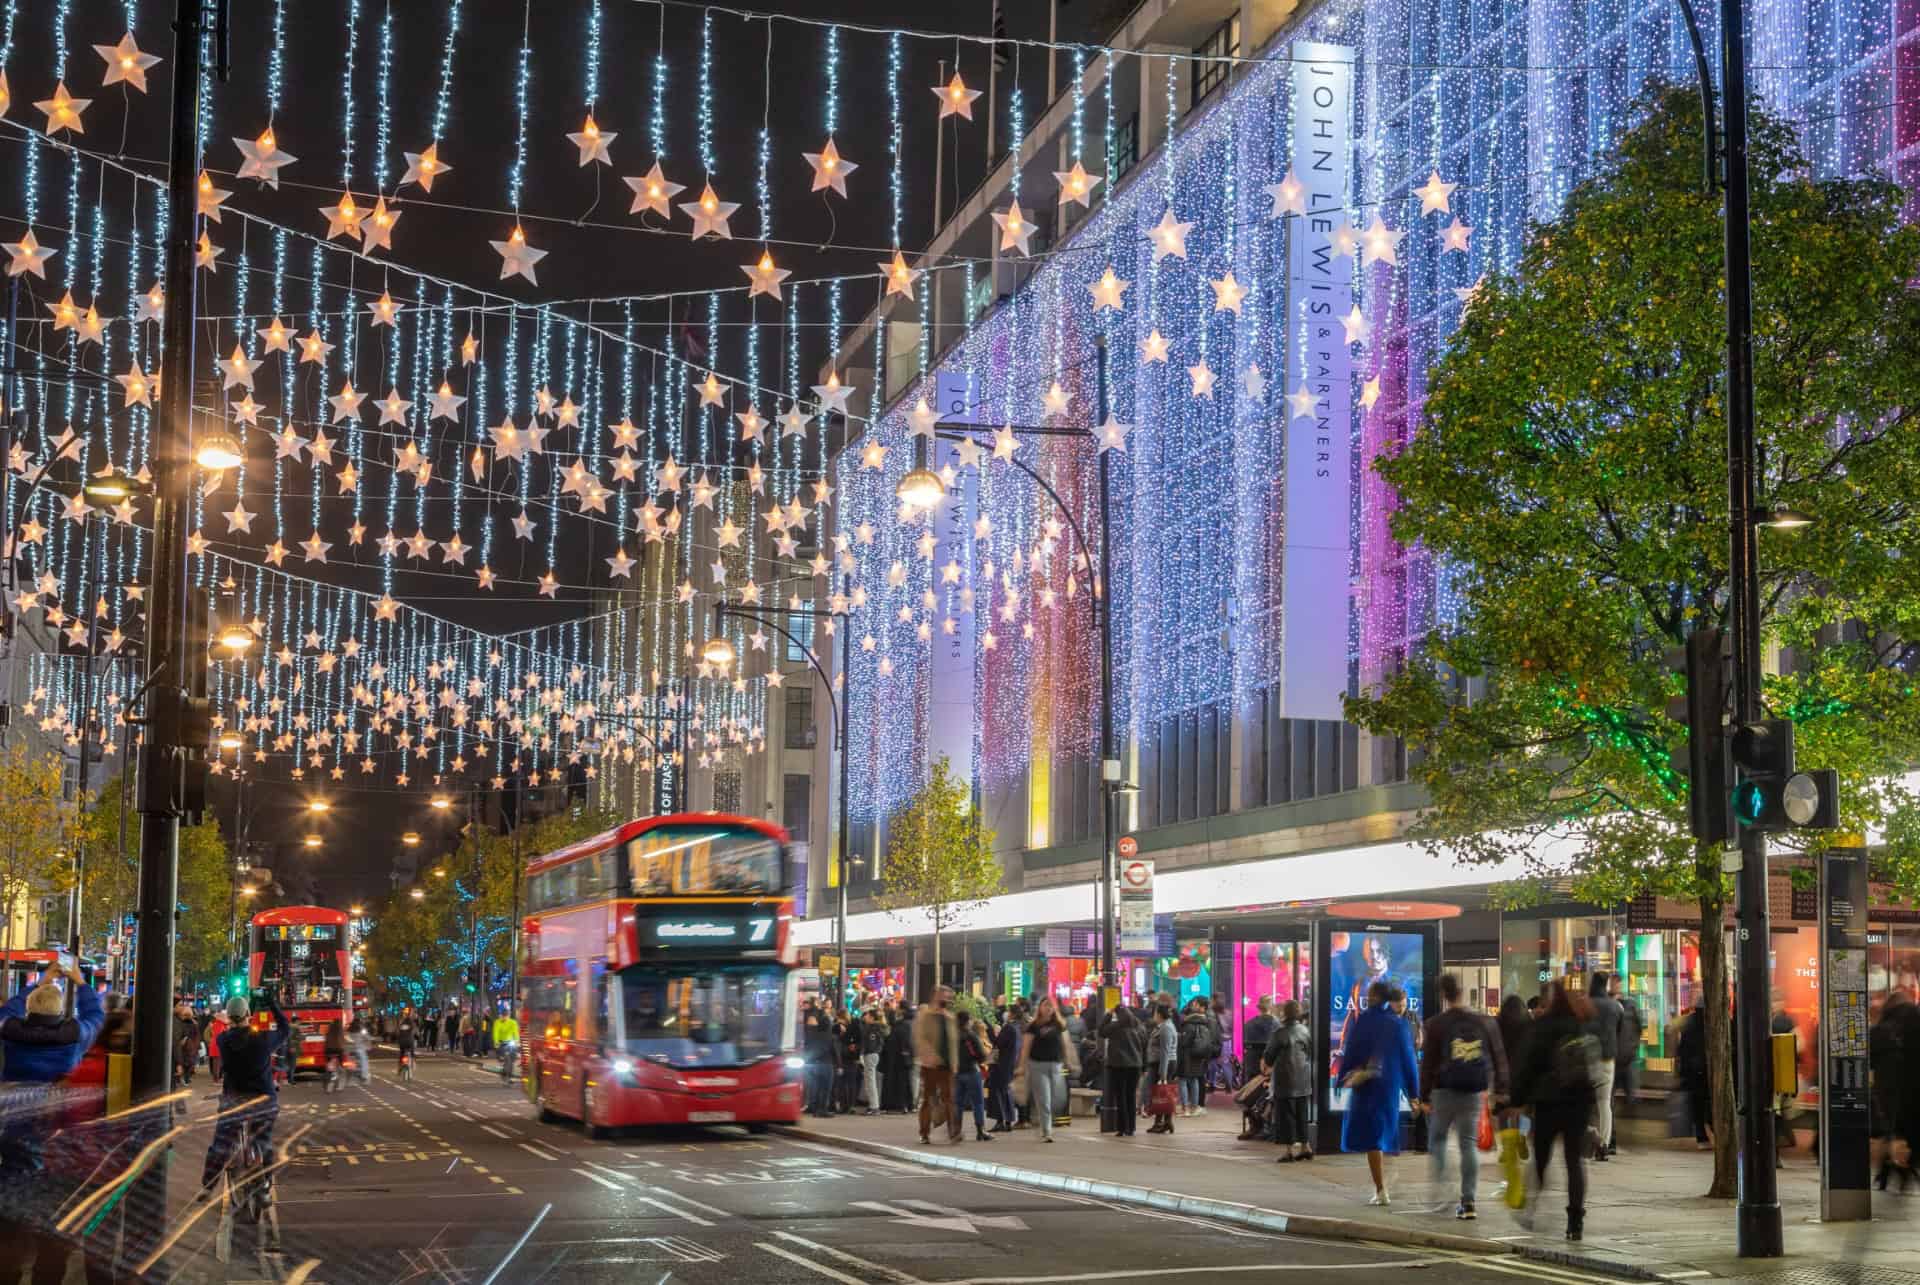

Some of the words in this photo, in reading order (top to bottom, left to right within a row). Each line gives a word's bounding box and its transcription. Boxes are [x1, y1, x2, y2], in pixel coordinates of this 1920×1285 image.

[1310, 66, 1334, 172] JOHN
[1310, 192, 1333, 315] LEWIS
[1317, 327, 1331, 338] &
[1316, 351, 1331, 478] PARTNERS
[661, 792, 673, 808] OF
[748, 919, 773, 941] 7
[294, 944, 309, 957] 98
[1333, 995, 1420, 1011] SAUE
